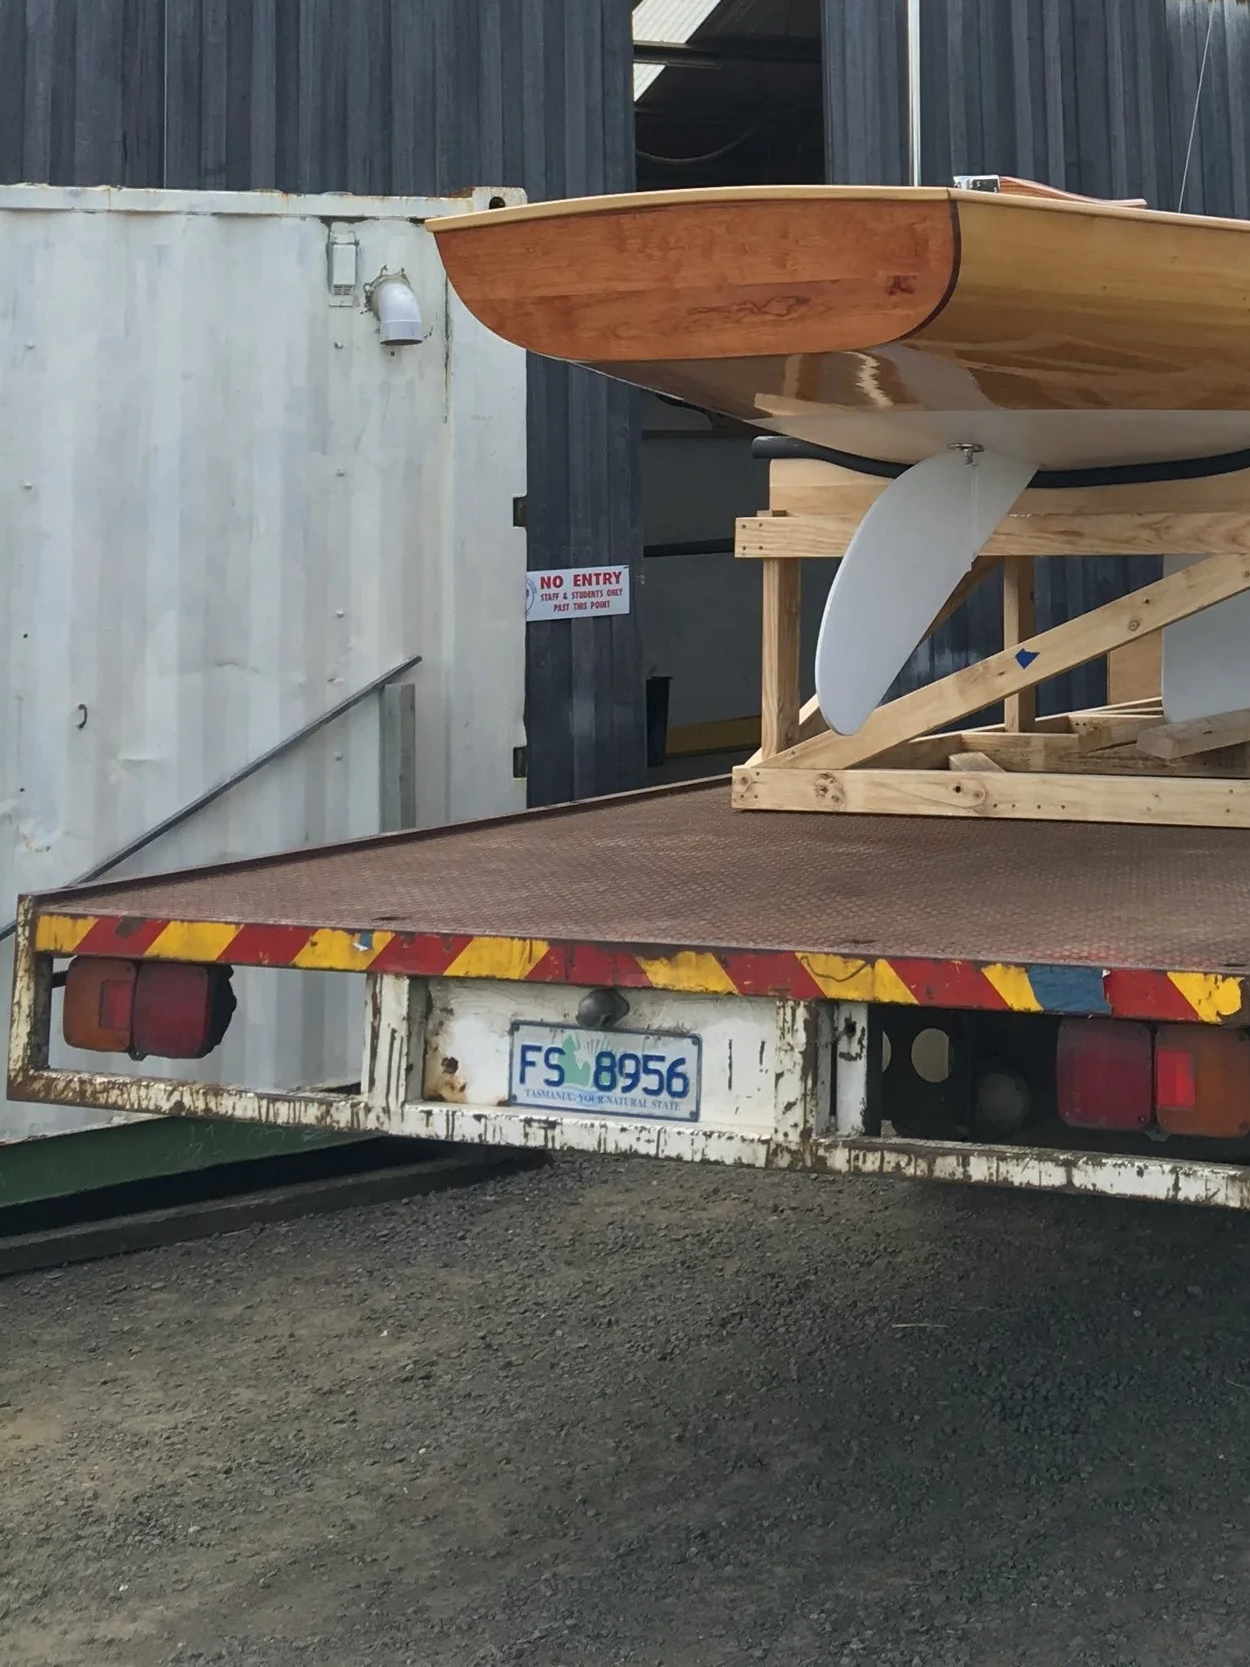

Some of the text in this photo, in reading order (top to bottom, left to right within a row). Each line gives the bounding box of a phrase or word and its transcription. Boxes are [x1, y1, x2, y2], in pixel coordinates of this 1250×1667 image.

[540, 575, 564, 590] NO
[573, 571, 622, 587] ENTRY
[540, 588, 623, 602] STAFF & STUDENTS ONLY
[553, 600, 611, 612] PAST THIS POINT
[519, 1043, 690, 1099] FS 8956
[606, 1096, 648, 1108] NATURAL
[651, 1099, 681, 1111] STATE
